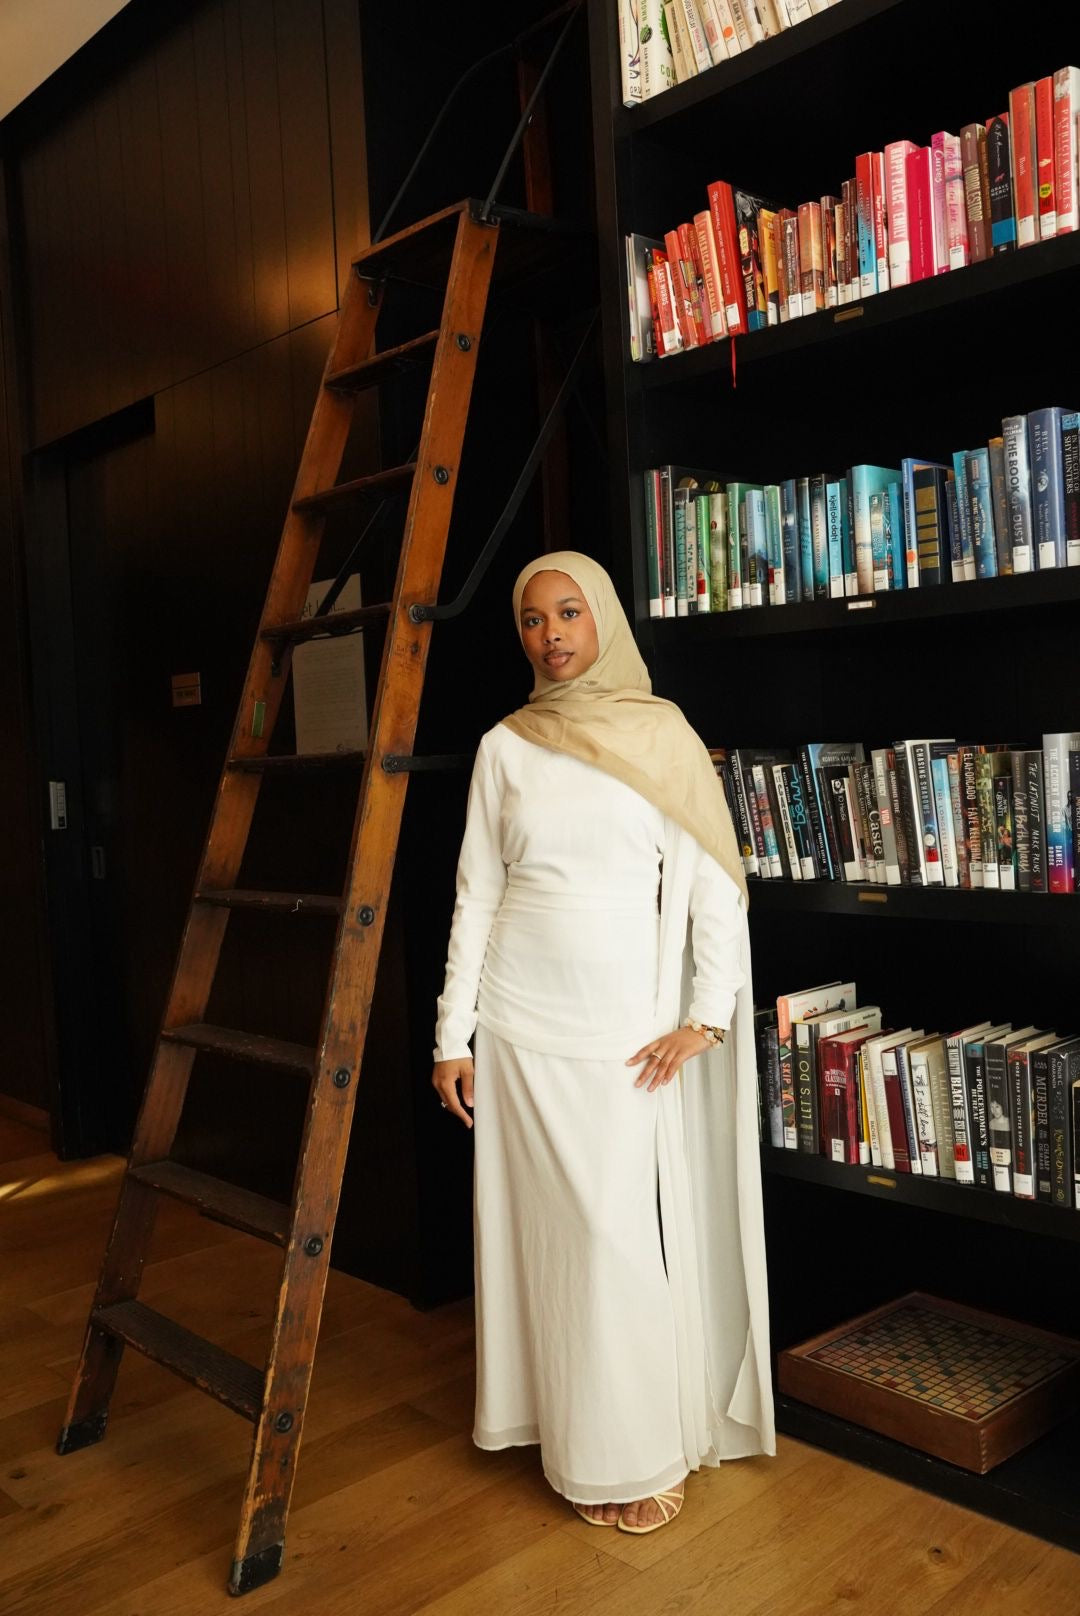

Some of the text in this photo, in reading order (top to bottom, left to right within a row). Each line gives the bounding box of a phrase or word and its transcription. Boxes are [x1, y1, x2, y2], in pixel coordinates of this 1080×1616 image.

[934, 150, 944, 183] Curves
[1061, 109, 1071, 210] PATRICIA WELLS
[890, 147, 906, 239] HAPPY PLACE EMILY
[991, 183, 1009, 192] GRAVE
[991, 188, 1008, 196] MERCY
[950, 203, 958, 223] Lake
[698, 231, 711, 270] AMERICAN
[660, 284, 668, 306] WORDS
[1007, 436, 1024, 544] THE BOOK OF DUST
[1065, 454, 1074, 494] HUNTERS
[676, 513, 687, 579] ALYS CLARE
[964, 753, 973, 761] EL
[731, 755, 740, 780] RETURN
[738, 794, 748, 835] DAMBUSTERS
[864, 774, 872, 808] Wilkerson
[916, 748, 930, 815] CHASING SHADOWS
[1051, 764, 1060, 796] ACCIDENT
[750, 791, 760, 832] UNTAMED
[1030, 781, 1039, 822] LATINIST
[1053, 800, 1060, 808] OF
[869, 810, 884, 855] Caste
[968, 807, 981, 864] FAYE KELLERMA
[1013, 791, 1031, 873] Cut Both Ways
[1054, 811, 1062, 833] COLOR
[782, 1062, 792, 1084] SKIP
[800, 1060, 810, 1081] DO
[800, 1087, 811, 1119] LET'S
[917, 1098, 927, 1118] still
[940, 1079, 950, 1123] LITTLE
[951, 1076, 963, 1107] BLACK
[1036, 1075, 1048, 1125] MURDER
[920, 1117, 929, 1137] love
[976, 1078, 987, 1146] POLICEWOMEN'S
[944, 1126, 952, 1153] LIFE
